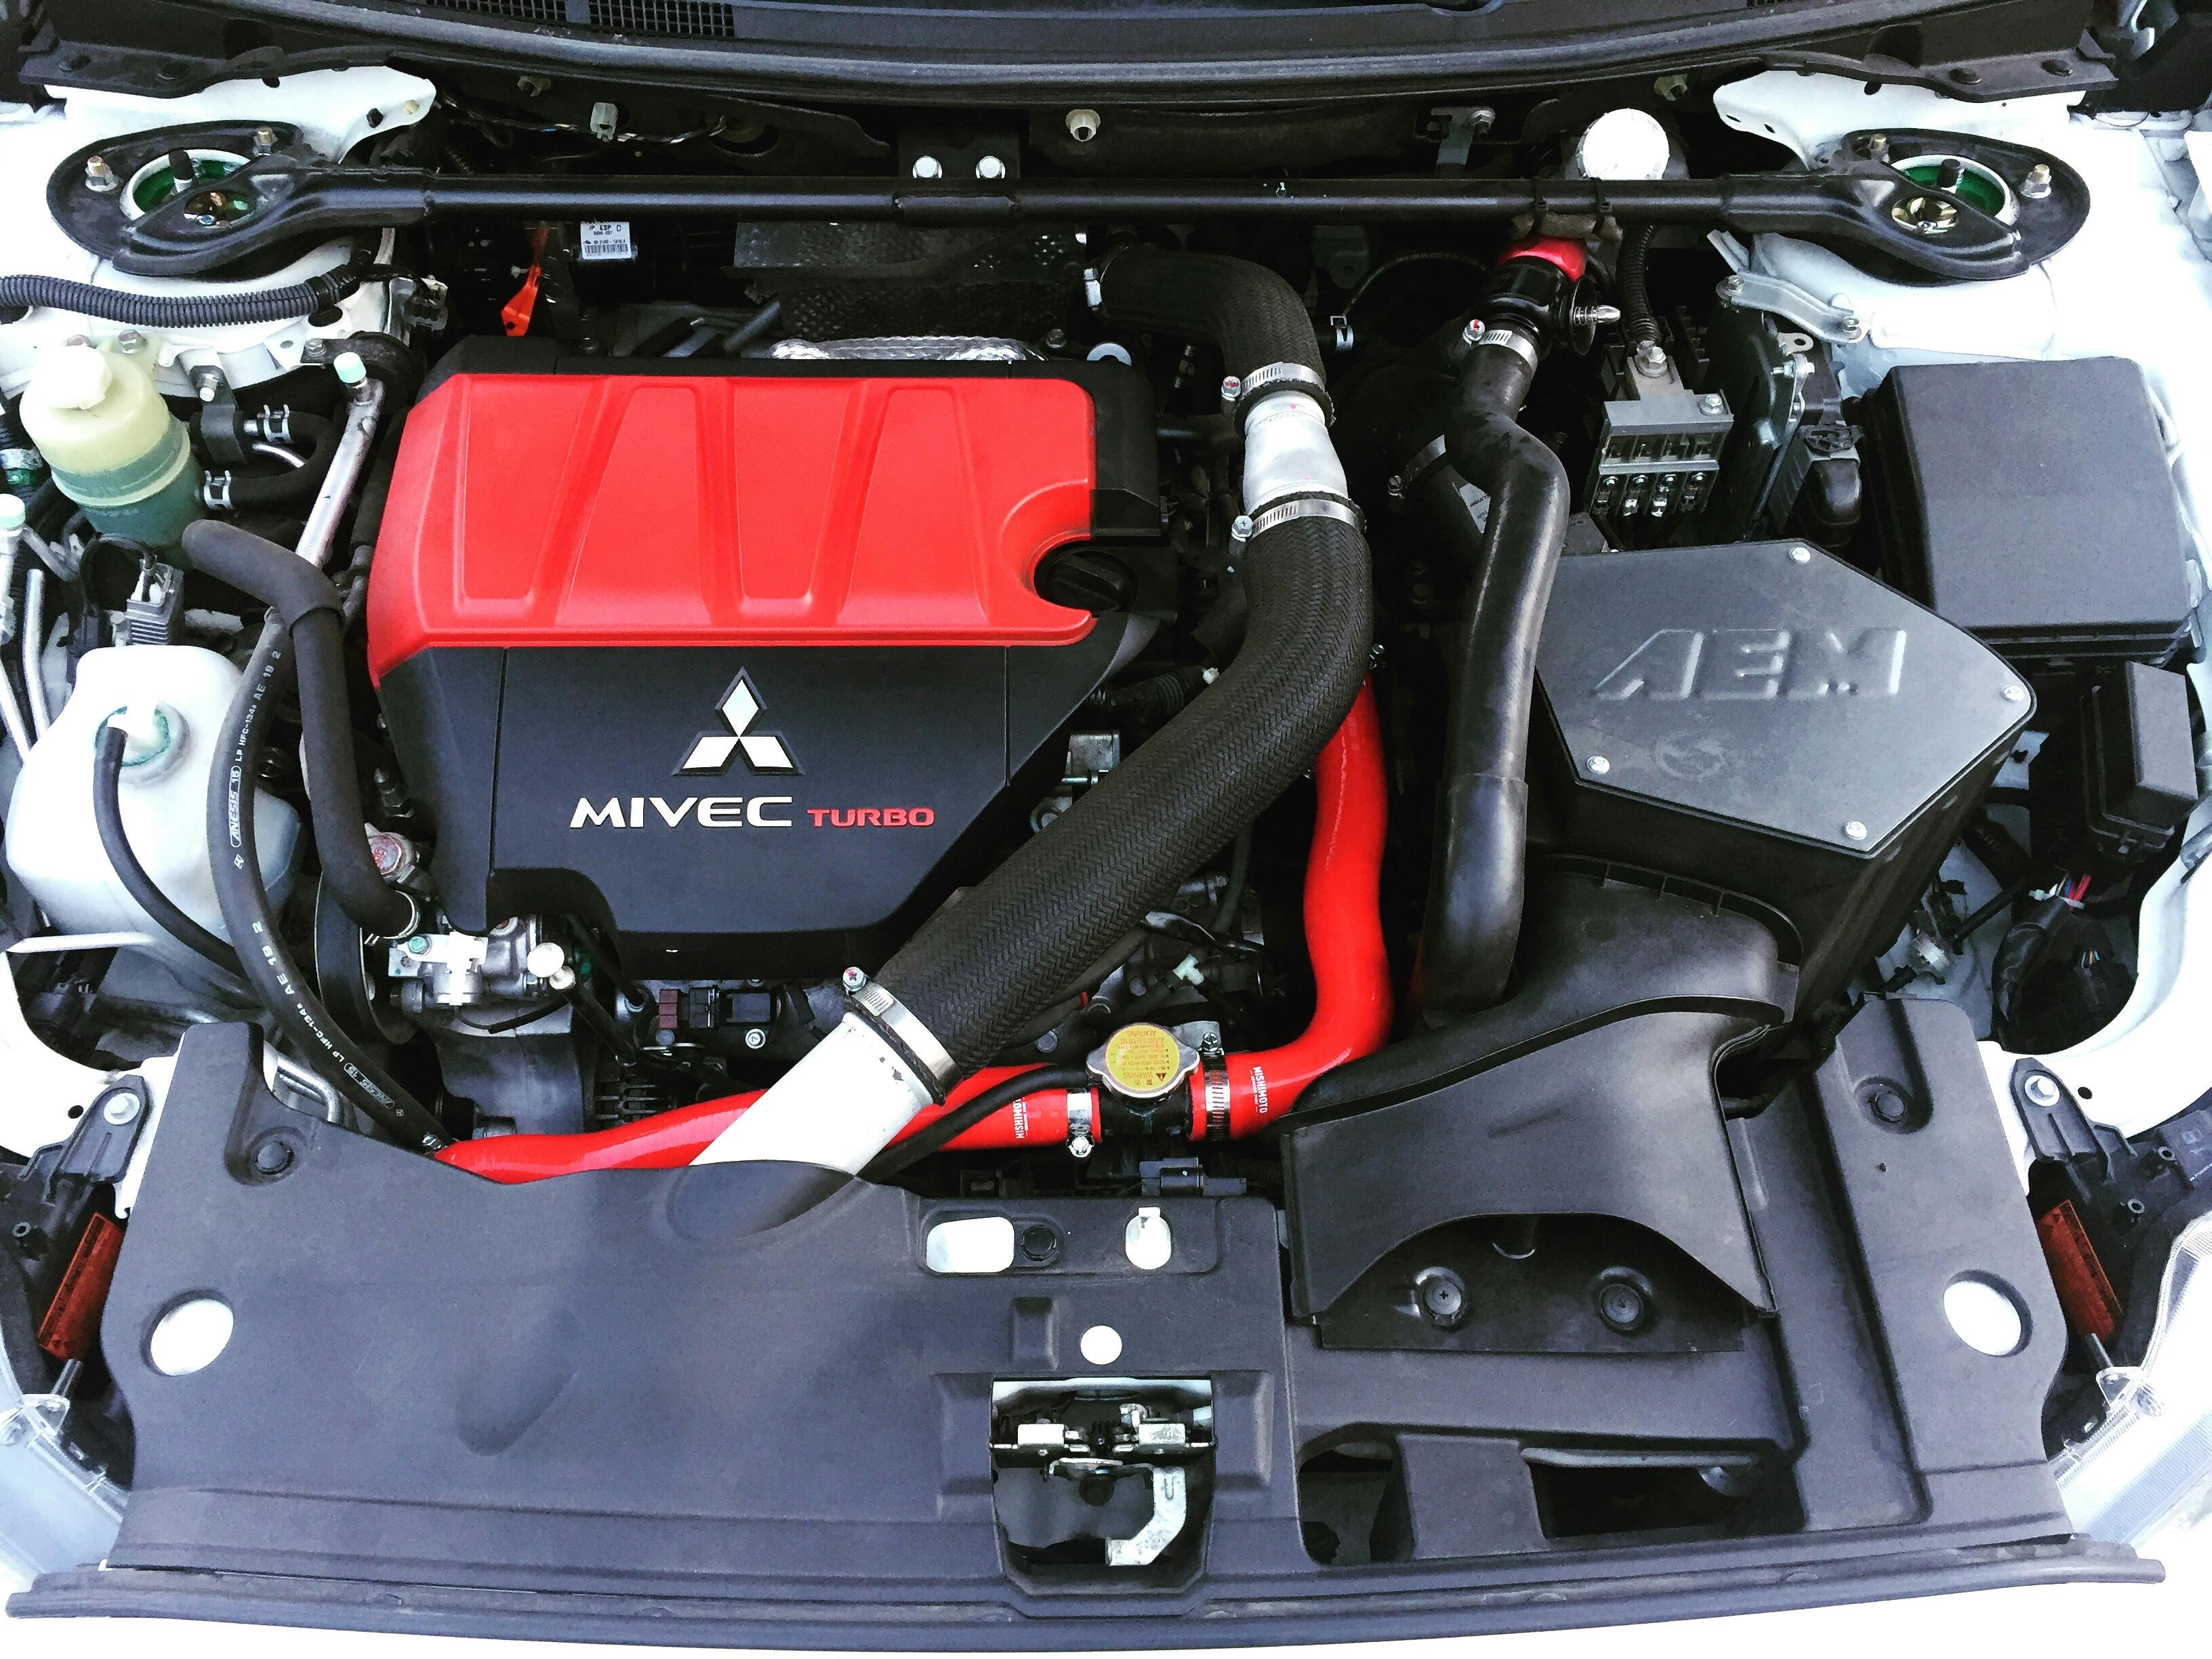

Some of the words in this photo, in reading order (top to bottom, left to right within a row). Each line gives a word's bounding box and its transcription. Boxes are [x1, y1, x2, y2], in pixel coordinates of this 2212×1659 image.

[1590, 628, 1908, 700] AEM
[235, 749, 243, 762] LP
[253, 684, 266, 701] AE
[272, 651, 281, 660] 2
[569, 796, 793, 828] MIVEC
[806, 808, 935, 827] TURBO
[252, 921, 263, 934] 2
[276, 972, 295, 995] AE
[332, 1051, 345, 1062] LP
[1253, 1066, 1268, 1113] MISHIMOTO
